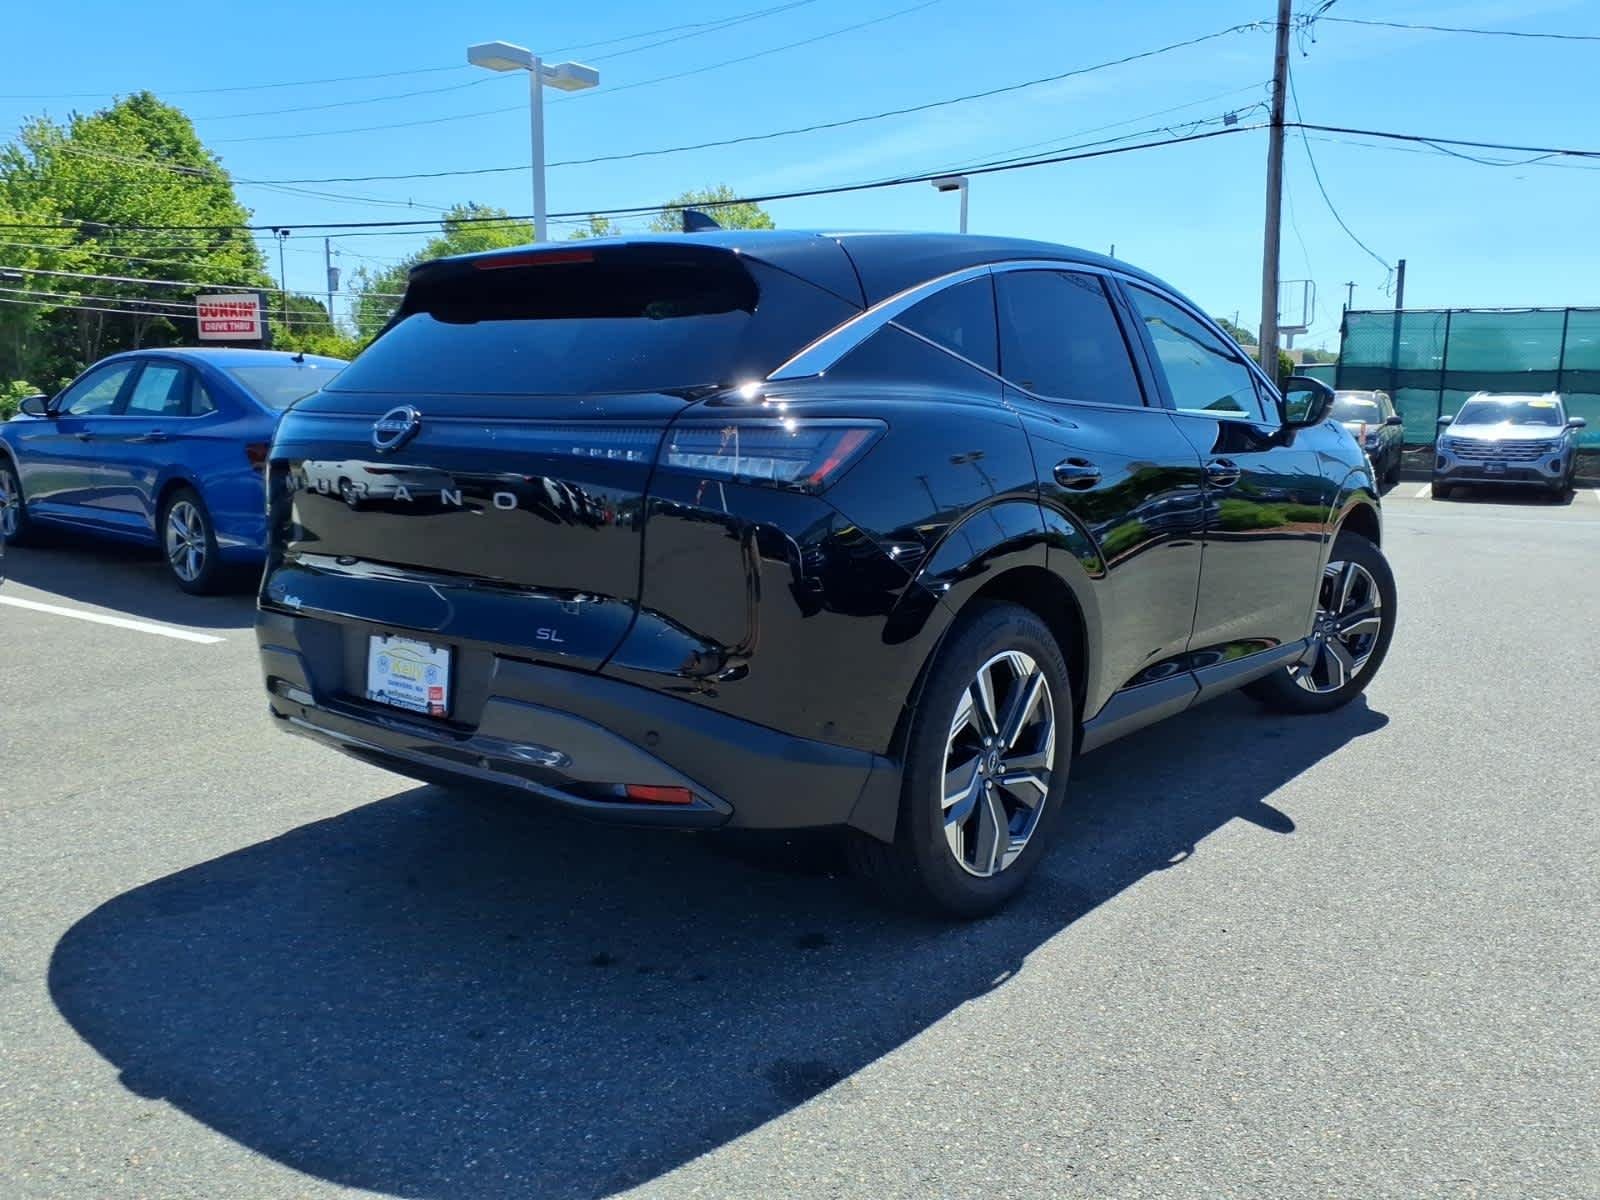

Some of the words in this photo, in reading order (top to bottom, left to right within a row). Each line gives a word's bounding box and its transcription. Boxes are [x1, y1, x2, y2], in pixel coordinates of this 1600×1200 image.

[204, 322, 228, 331] DRIVE
[229, 321, 251, 331] THRU
[285, 473, 518, 510] MURANO
[536, 627, 565, 643] SL
